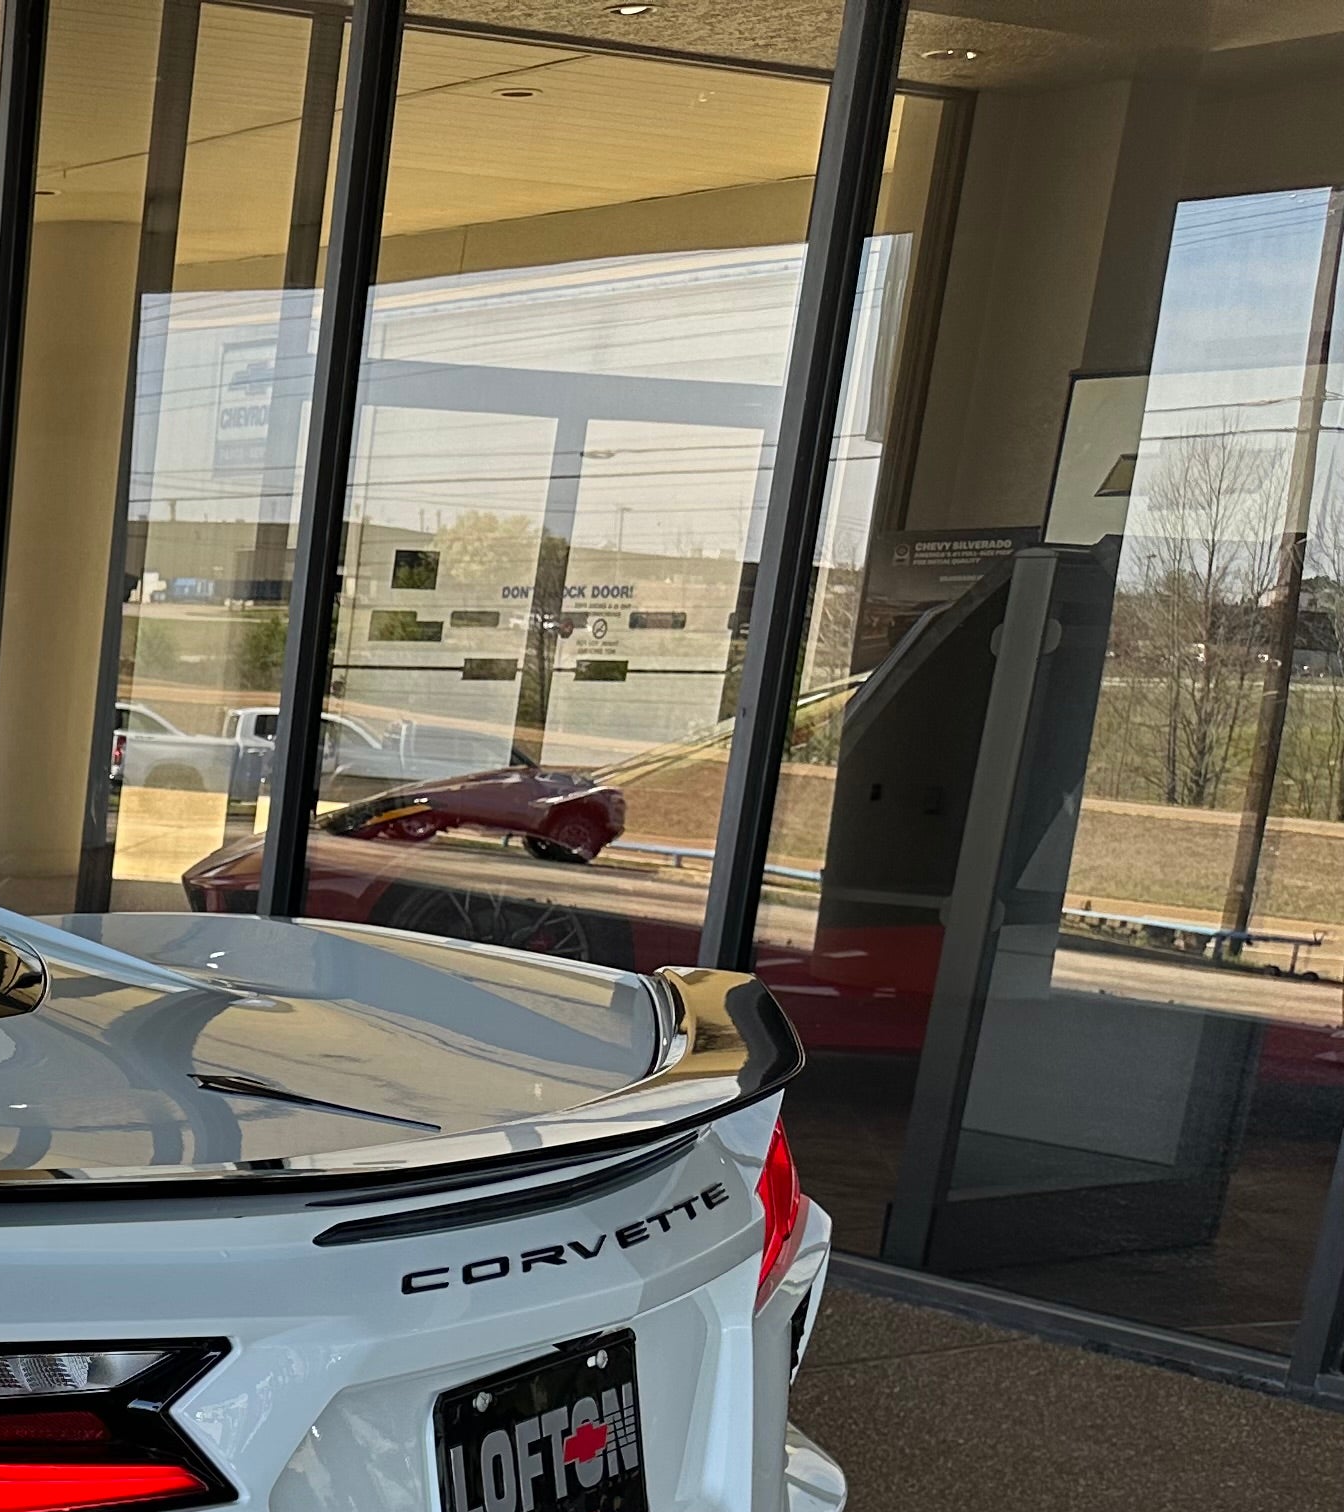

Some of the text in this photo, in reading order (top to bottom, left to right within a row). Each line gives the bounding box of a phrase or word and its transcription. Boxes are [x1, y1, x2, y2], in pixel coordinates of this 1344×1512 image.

[220, 405, 270, 430] CHEVRO
[915, 539, 1012, 552] CHEVY SILVERADO
[591, 585, 634, 599] DOOR!
[401, 1182, 730, 1295] CORVETTE
